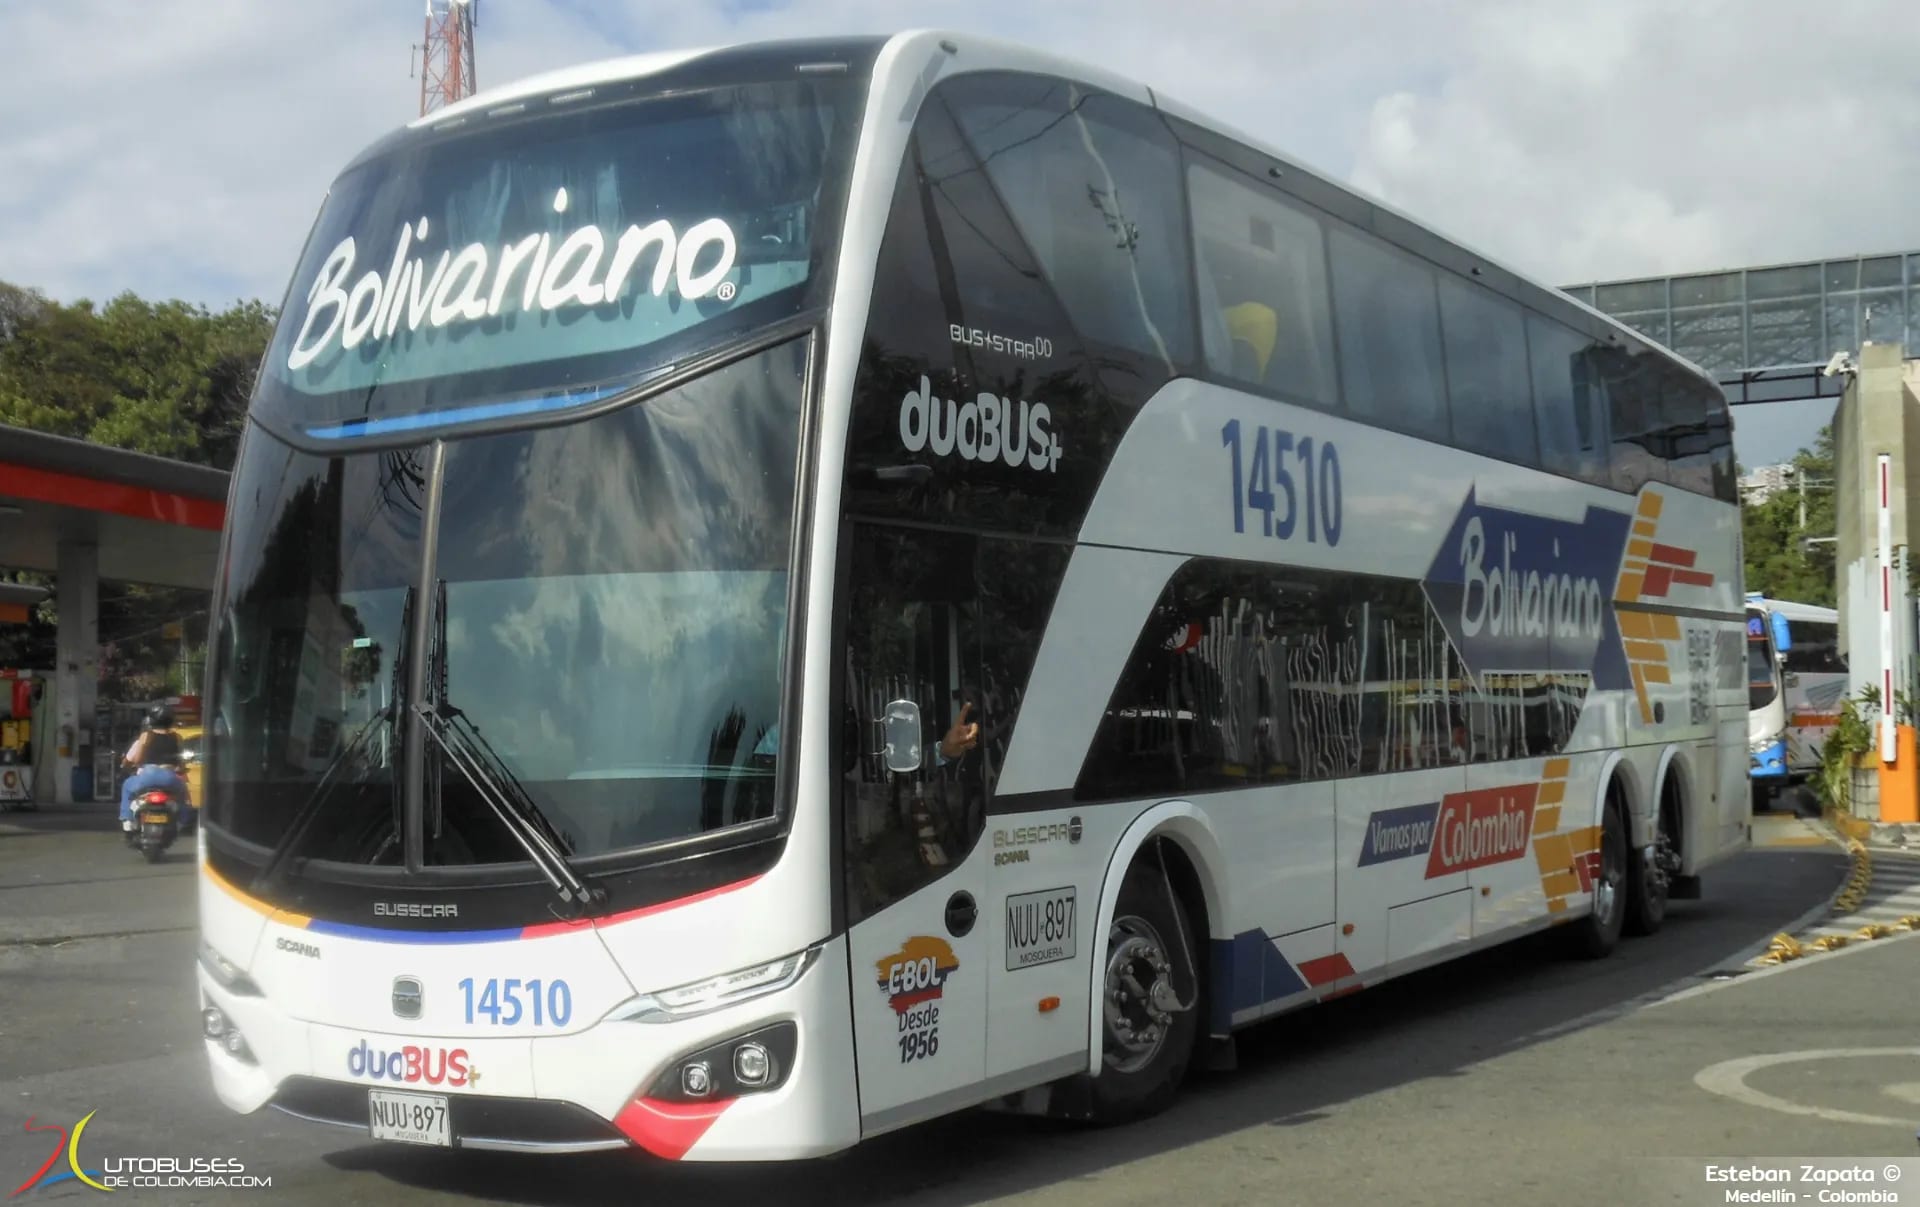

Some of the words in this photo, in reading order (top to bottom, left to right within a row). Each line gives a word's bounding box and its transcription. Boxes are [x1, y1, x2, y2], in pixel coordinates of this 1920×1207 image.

[1221, 418, 1343, 547] 14510
[1460, 516, 1604, 640] Bolivariano
[993, 823, 1068, 848] BUSSCAR
[1372, 821, 1409, 855] Vamos
[1411, 820, 1431, 854] por
[1440, 797, 1526, 867] Colombia
[994, 850, 1030, 866] SCANIA
[374, 902, 458, 918] BUSSCAR
[276, 937, 321, 960] SCANIA
[1020, 947, 1064, 964] MOSQUERA
[458, 977, 572, 1028] 14510
[898, 1002, 939, 1032] Desde
[898, 1028, 939, 1064] 1956
